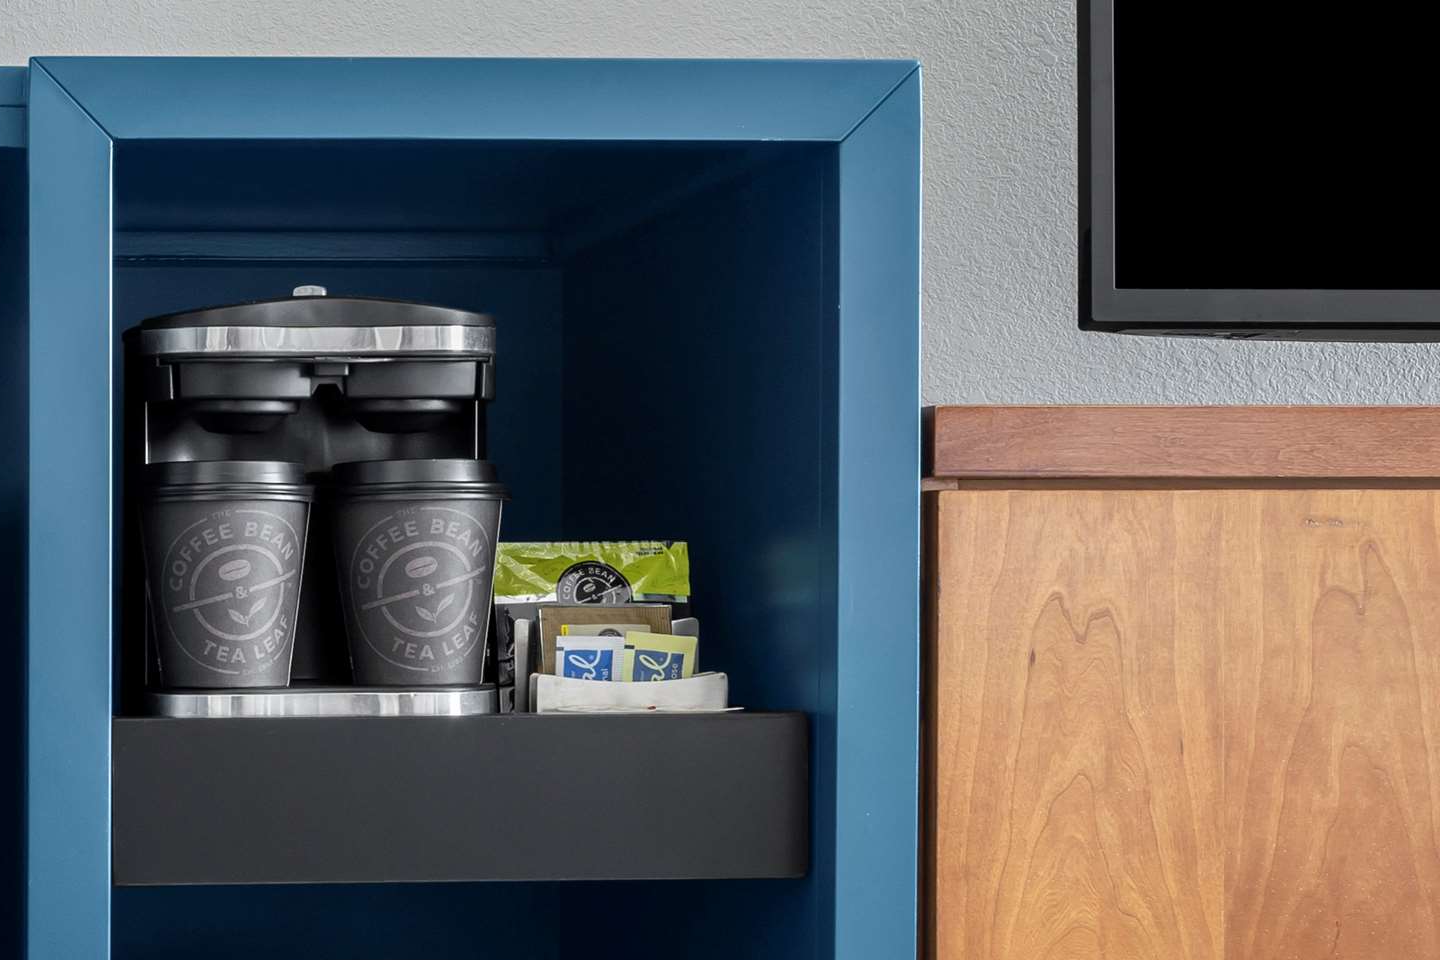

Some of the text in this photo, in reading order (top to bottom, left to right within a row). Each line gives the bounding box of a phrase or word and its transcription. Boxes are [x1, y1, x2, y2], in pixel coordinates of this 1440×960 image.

[170, 521, 294, 591] COFFEE BEAN
[358, 518, 483, 589] COFFEE BEAN
[235, 586, 249, 599] &
[422, 583, 436, 596] &
[562, 567, 616, 600] COFFEE BEAN
[203, 615, 288, 663] TEA LEAF
[391, 611, 478, 661] TEA LEAF
